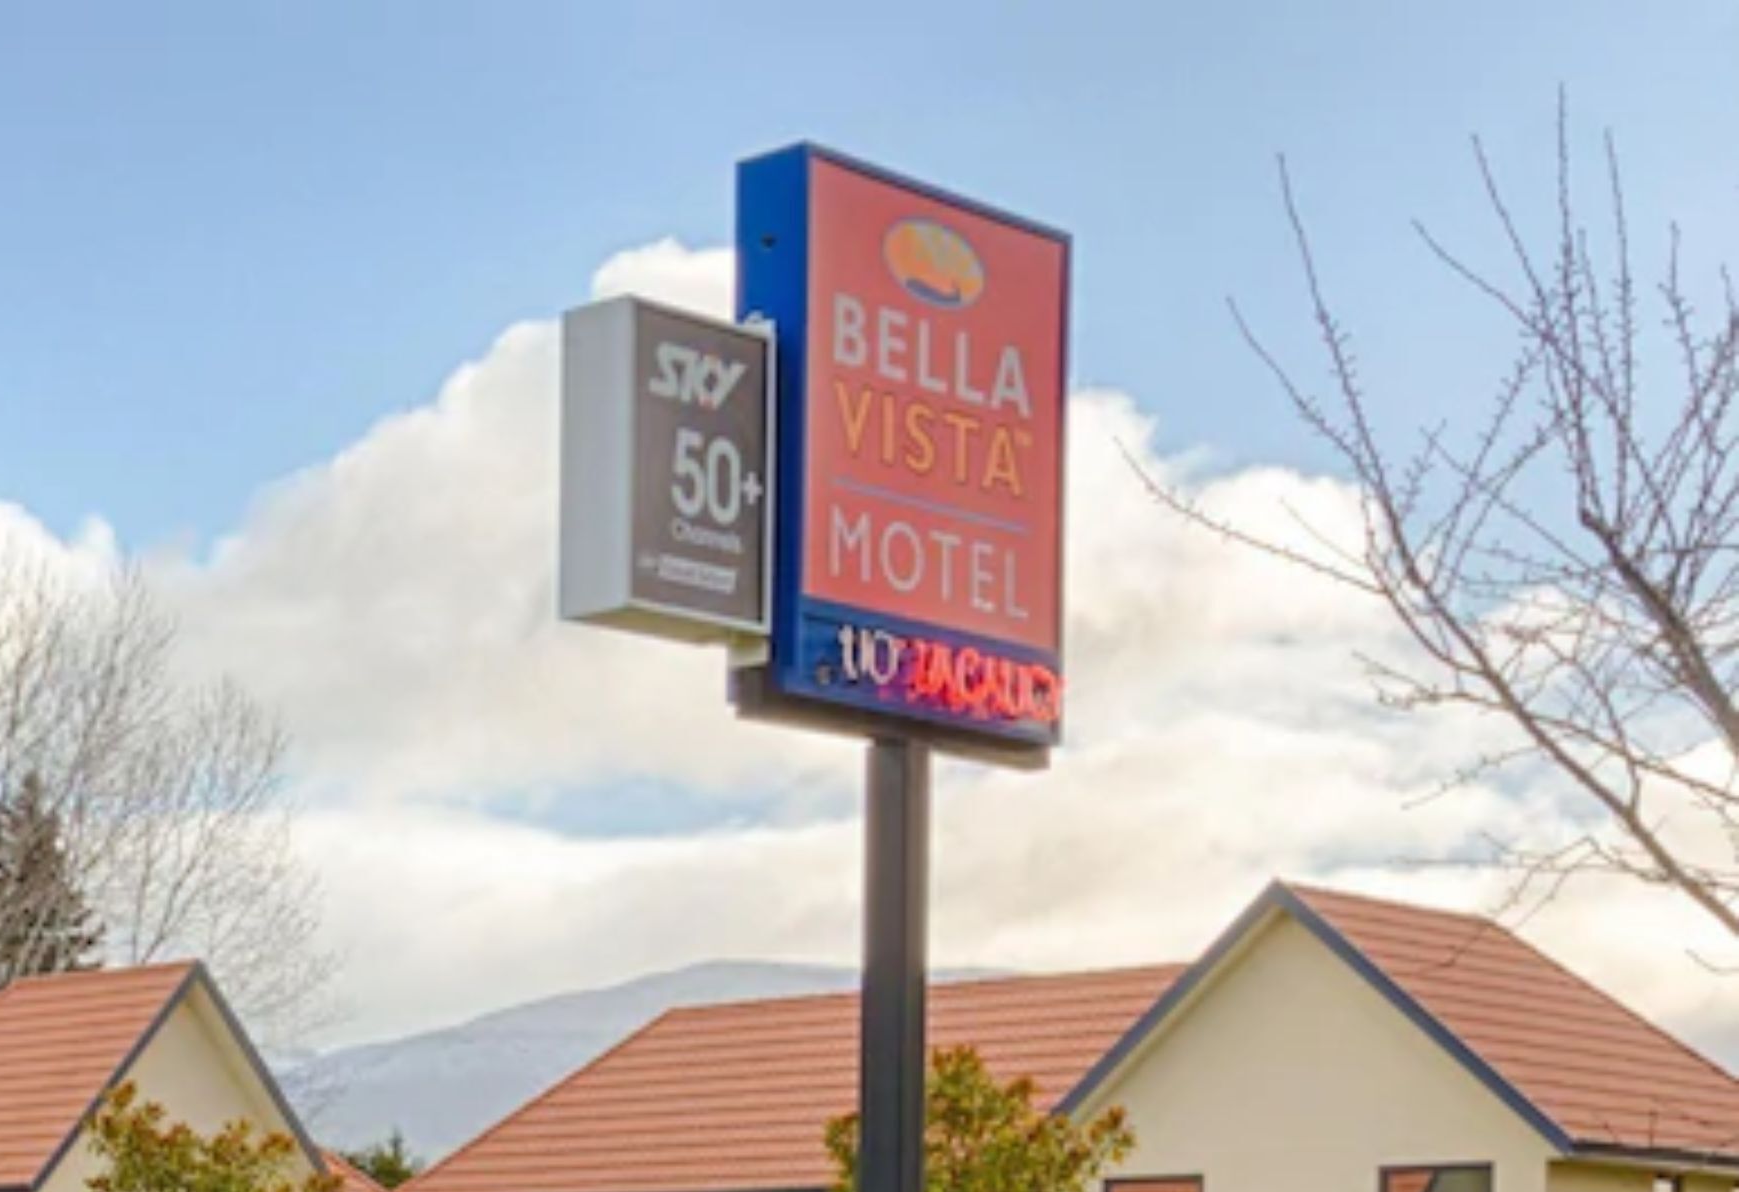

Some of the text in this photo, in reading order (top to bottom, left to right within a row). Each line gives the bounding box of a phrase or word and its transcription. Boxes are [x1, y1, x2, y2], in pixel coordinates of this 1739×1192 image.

[648, 341, 748, 410] SKY
[833, 292, 1032, 419] BELLA
[671, 427, 763, 525] 50+
[828, 503, 1030, 621] MOTEL
